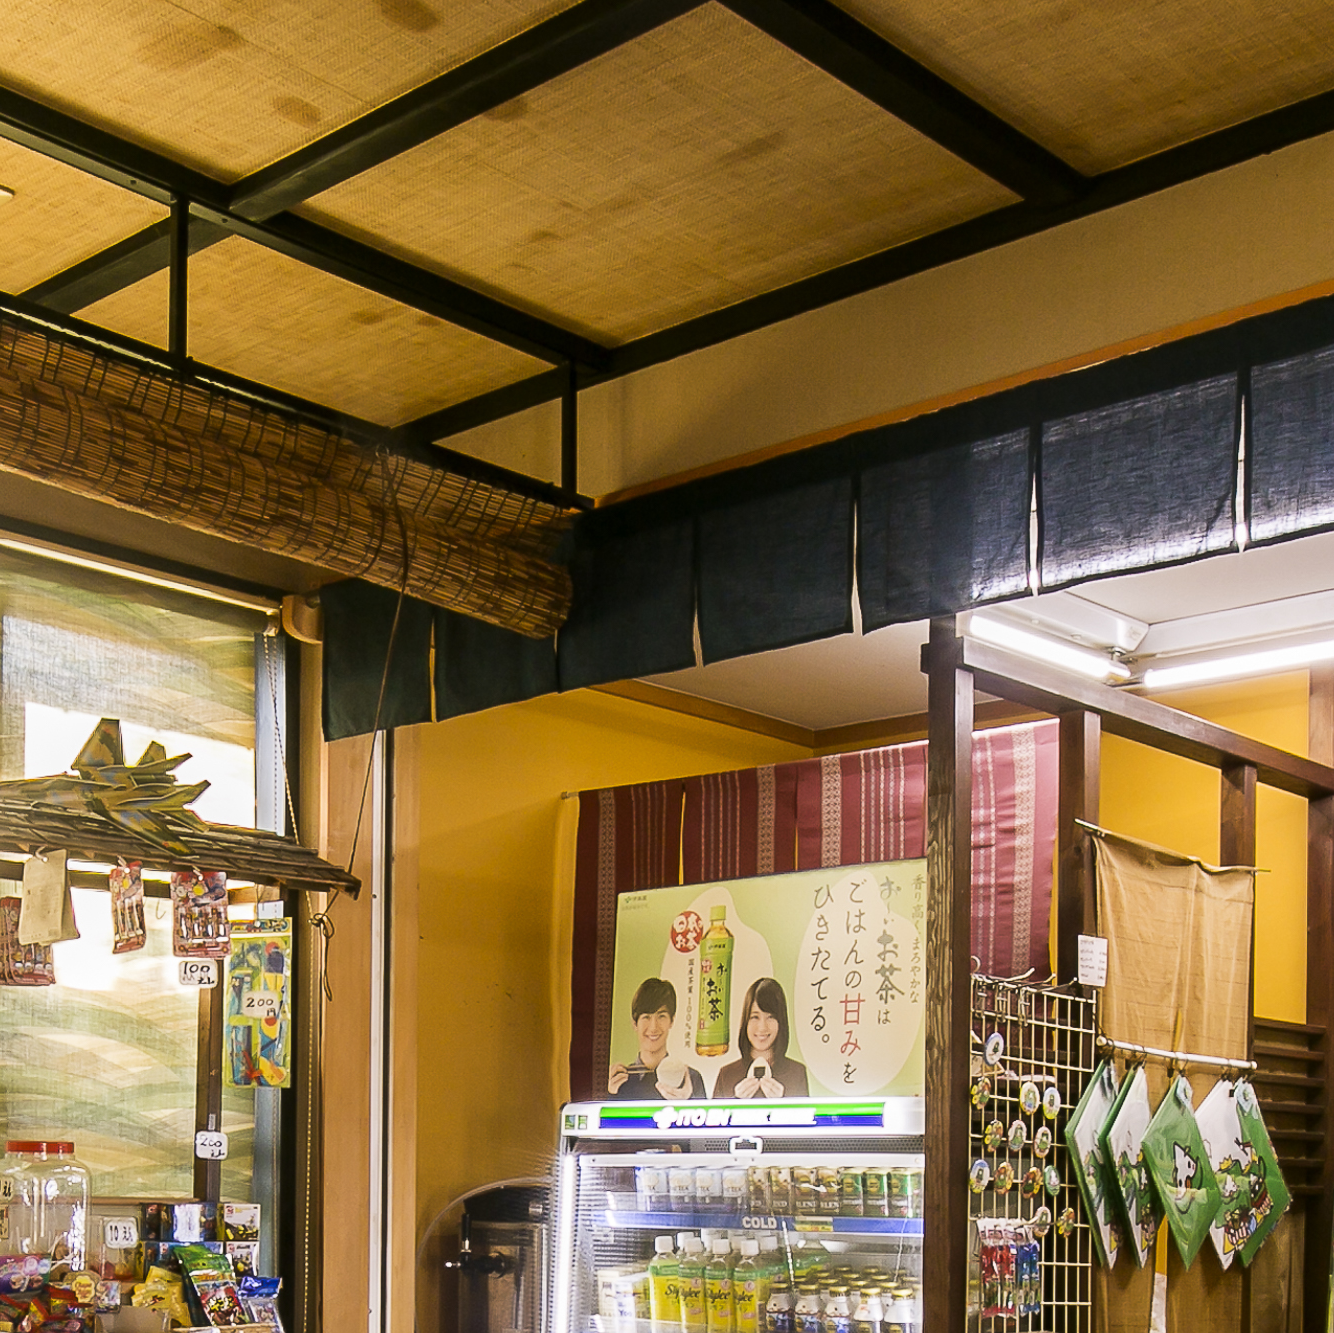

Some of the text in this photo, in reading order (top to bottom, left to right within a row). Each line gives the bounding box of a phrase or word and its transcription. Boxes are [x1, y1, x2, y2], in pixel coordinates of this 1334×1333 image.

[810, 883, 835, 1044] ひきたてる。
[838, 878, 868, 1085] ごはんの甘みを
[742, 1216, 777, 1229] COLD
